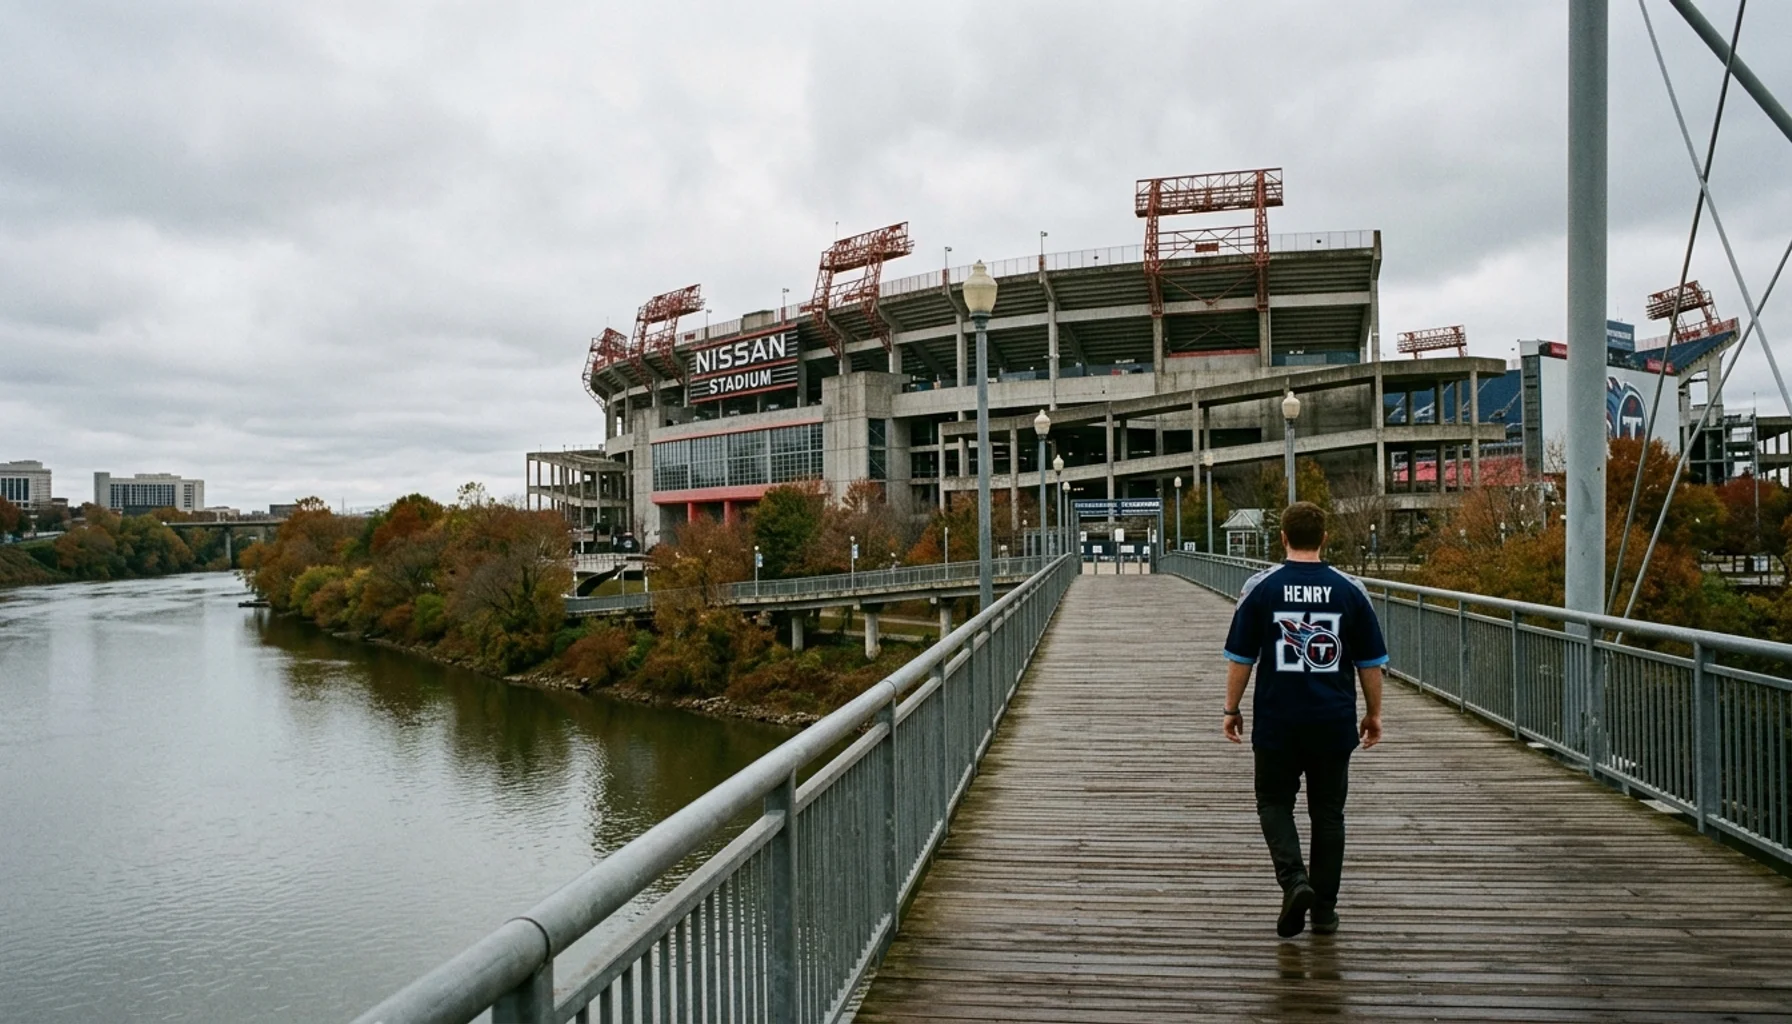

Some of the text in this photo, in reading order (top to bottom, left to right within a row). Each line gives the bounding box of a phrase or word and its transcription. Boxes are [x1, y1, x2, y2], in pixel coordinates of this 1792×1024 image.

[696, 333, 785, 374] NISSAN
[709, 369, 771, 394] STADIUM
[1283, 585, 1332, 603] HENRY
[1311, 643, 1334, 661] T
